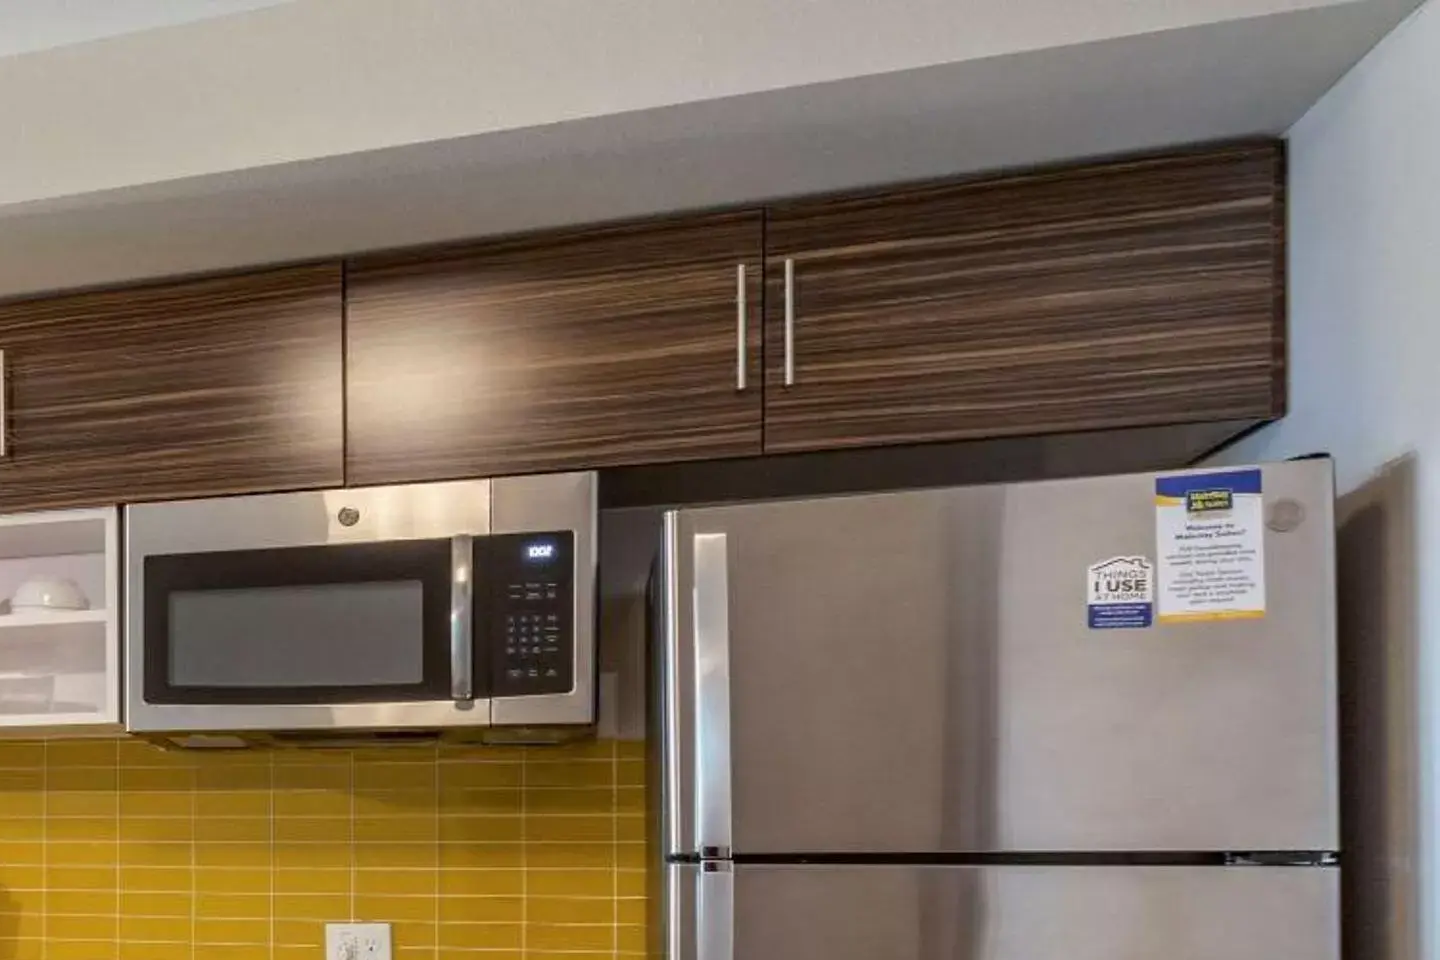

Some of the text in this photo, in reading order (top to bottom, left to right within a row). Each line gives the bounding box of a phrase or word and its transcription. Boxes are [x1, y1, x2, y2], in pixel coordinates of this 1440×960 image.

[1096, 570, 1146, 580] THINGS
[1095, 579, 1146, 592] I USE
[1095, 592, 1146, 601] AT HOME
